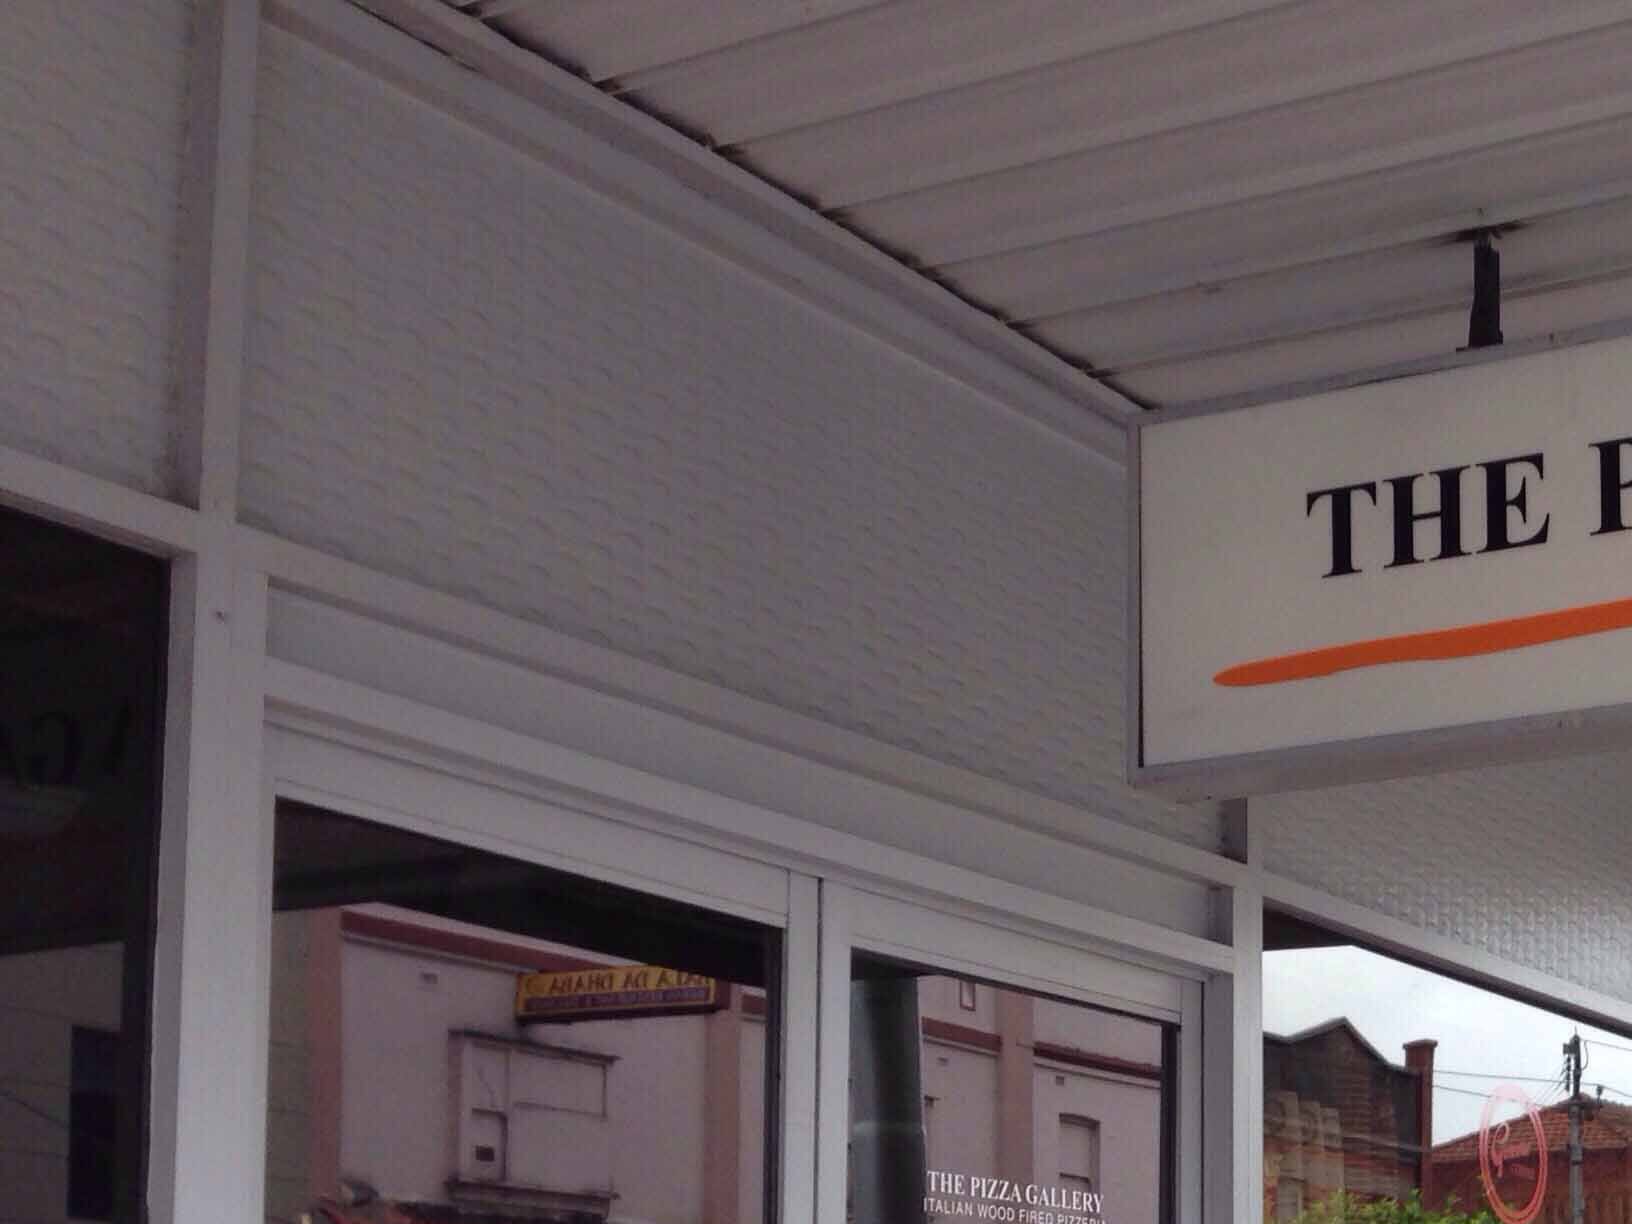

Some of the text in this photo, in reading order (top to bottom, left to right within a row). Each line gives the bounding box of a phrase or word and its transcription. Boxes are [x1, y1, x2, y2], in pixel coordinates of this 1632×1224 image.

[1306, 453, 1551, 578] THE
[924, 1198, 974, 1217] ITALIAN
[977, 1204, 1015, 1222] WOOD
[1019, 1209, 1053, 1224] FIRED
[927, 1171, 1105, 1213] THE PIZZA GALLERY
